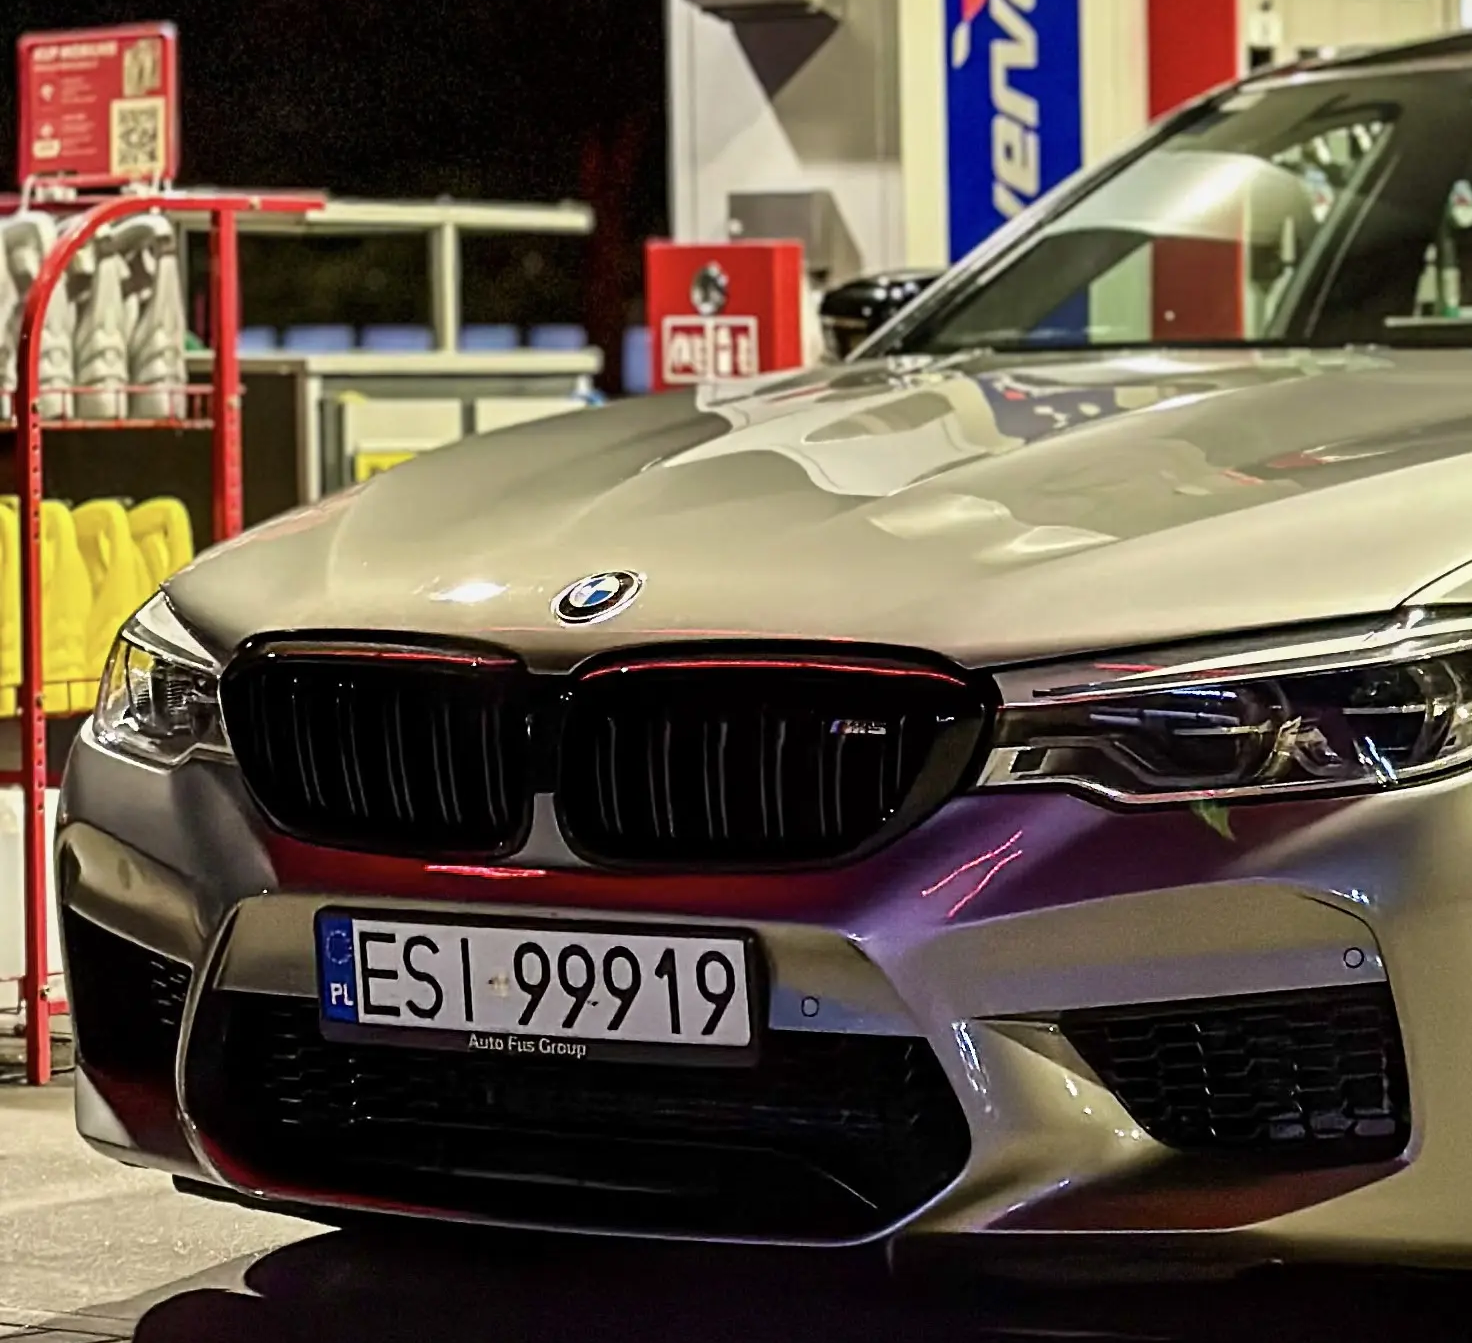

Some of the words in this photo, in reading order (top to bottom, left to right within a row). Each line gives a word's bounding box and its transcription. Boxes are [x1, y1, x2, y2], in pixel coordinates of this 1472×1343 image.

[329, 982, 355, 1006] PL
[358, 930, 475, 1022] ESI
[512, 940, 737, 1037] 99919
[468, 1032, 504, 1052] Auto
[507, 1035, 536, 1053] Fus
[538, 1037, 587, 1060] Group
